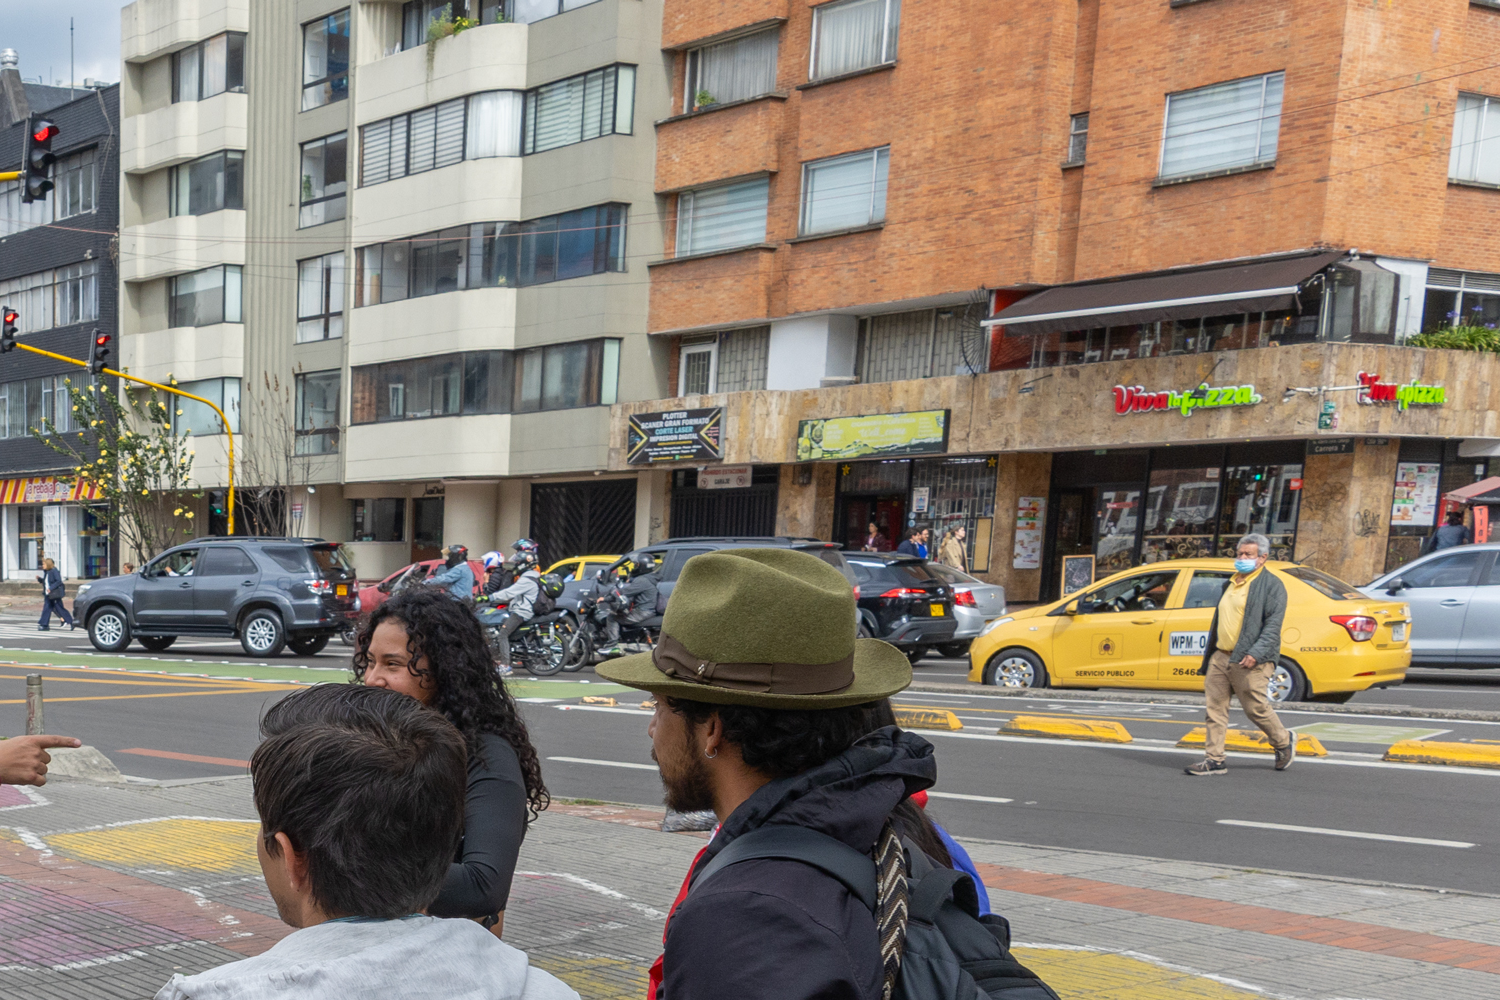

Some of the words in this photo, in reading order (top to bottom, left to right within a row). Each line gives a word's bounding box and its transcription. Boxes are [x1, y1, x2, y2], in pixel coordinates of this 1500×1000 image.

[1112, 385, 1169, 414] Viva
[662, 411, 688, 420] PLOTTER
[664, 419, 681, 427] GRAN
[681, 417, 710, 426] FORMATO
[1171, 635, 1208, 649] WPM-0
[1172, 667, 1198, 676] 2646
